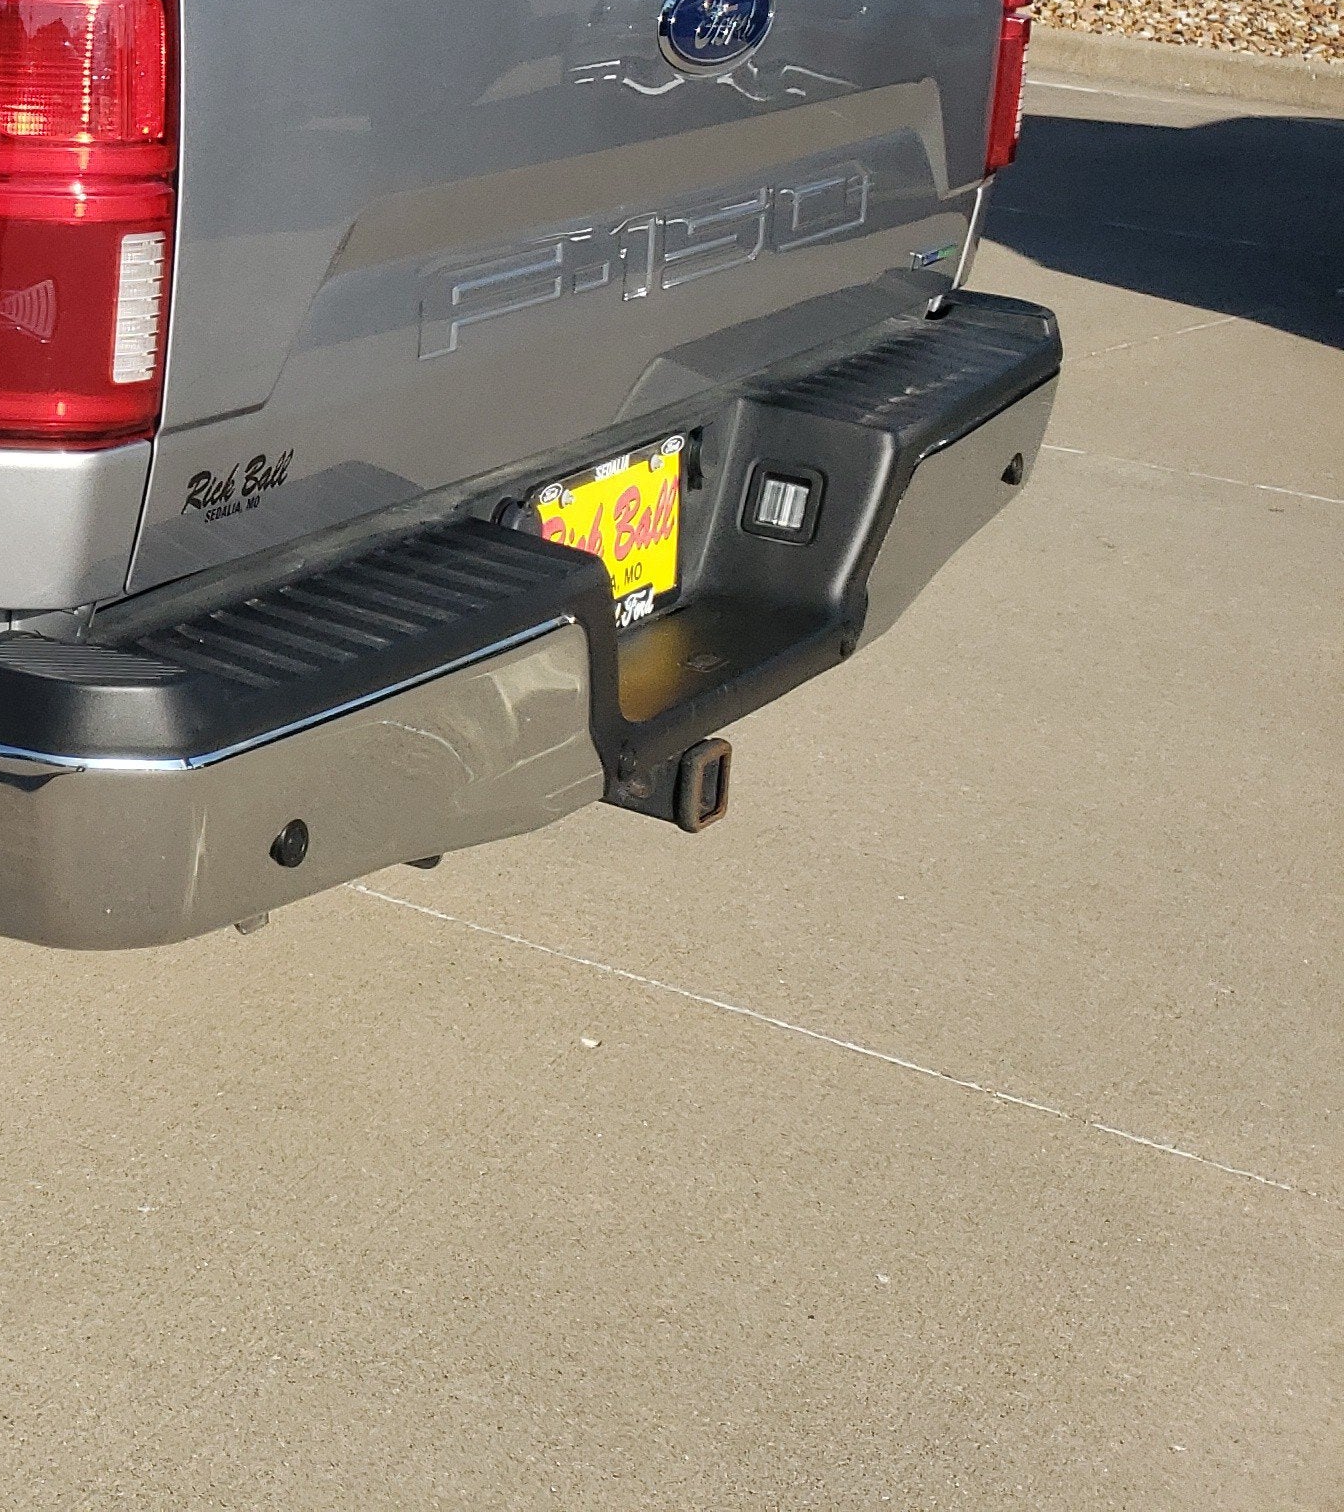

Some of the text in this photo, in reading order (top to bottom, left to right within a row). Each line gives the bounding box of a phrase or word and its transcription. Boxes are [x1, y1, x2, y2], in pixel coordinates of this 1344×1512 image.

[180, 448, 295, 515] Rick Ball
[613, 474, 680, 561] Ball
[624, 561, 643, 586] MO
